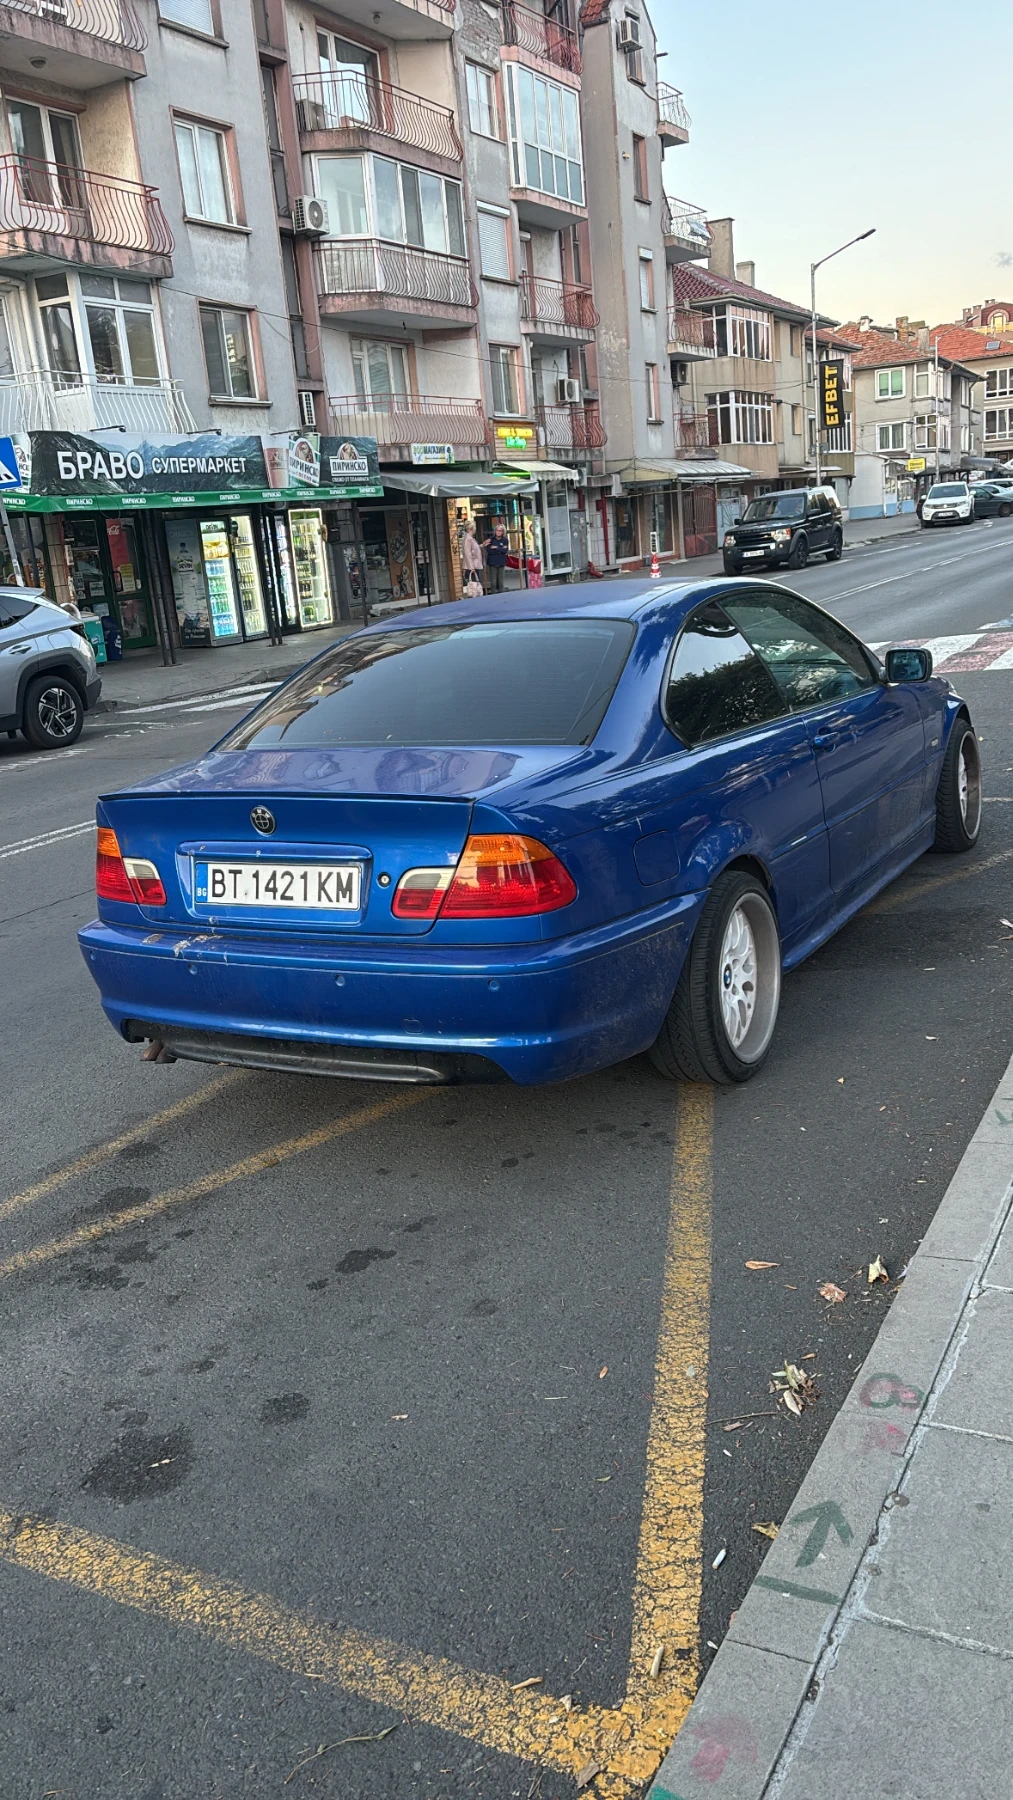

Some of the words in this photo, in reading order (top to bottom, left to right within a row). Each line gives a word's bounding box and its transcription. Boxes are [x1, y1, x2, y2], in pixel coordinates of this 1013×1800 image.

[824, 364, 840, 426] EFBET
[57, 451, 145, 480] БРАВО
[151, 457, 247, 474] СУПЕРМАРКЕТ
[332, 461, 367, 471] ПИРИНСКО
[197, 887, 207, 897] BG
[212, 868, 243, 899] BT
[252, 869, 309, 902] 1421
[317, 871, 353, 904] KM
